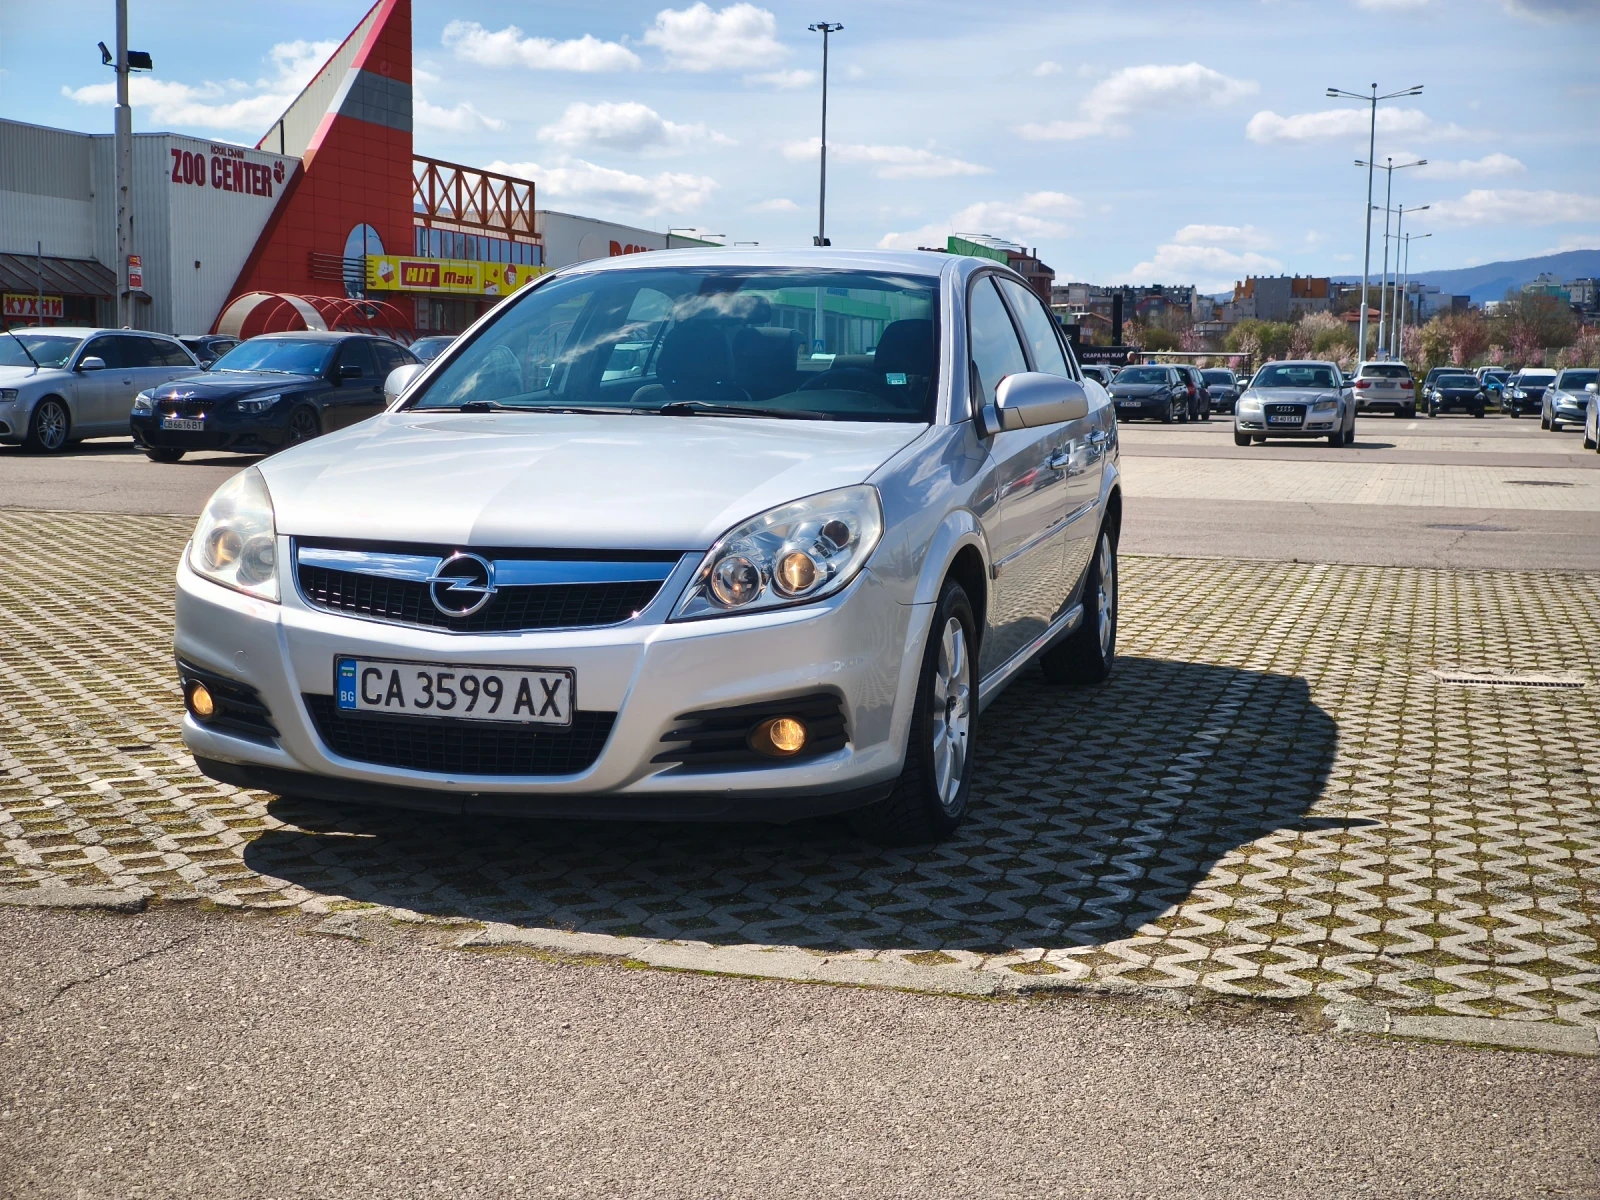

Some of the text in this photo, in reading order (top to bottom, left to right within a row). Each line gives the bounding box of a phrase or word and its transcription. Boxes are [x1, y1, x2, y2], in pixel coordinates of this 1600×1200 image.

[171, 148, 273, 198] ZOO CENTER
[406, 267, 435, 283] HIT
[6, 296, 62, 316] КУХНИ
[340, 690, 355, 702] BG
[361, 667, 562, 717] CA 3599 AX
